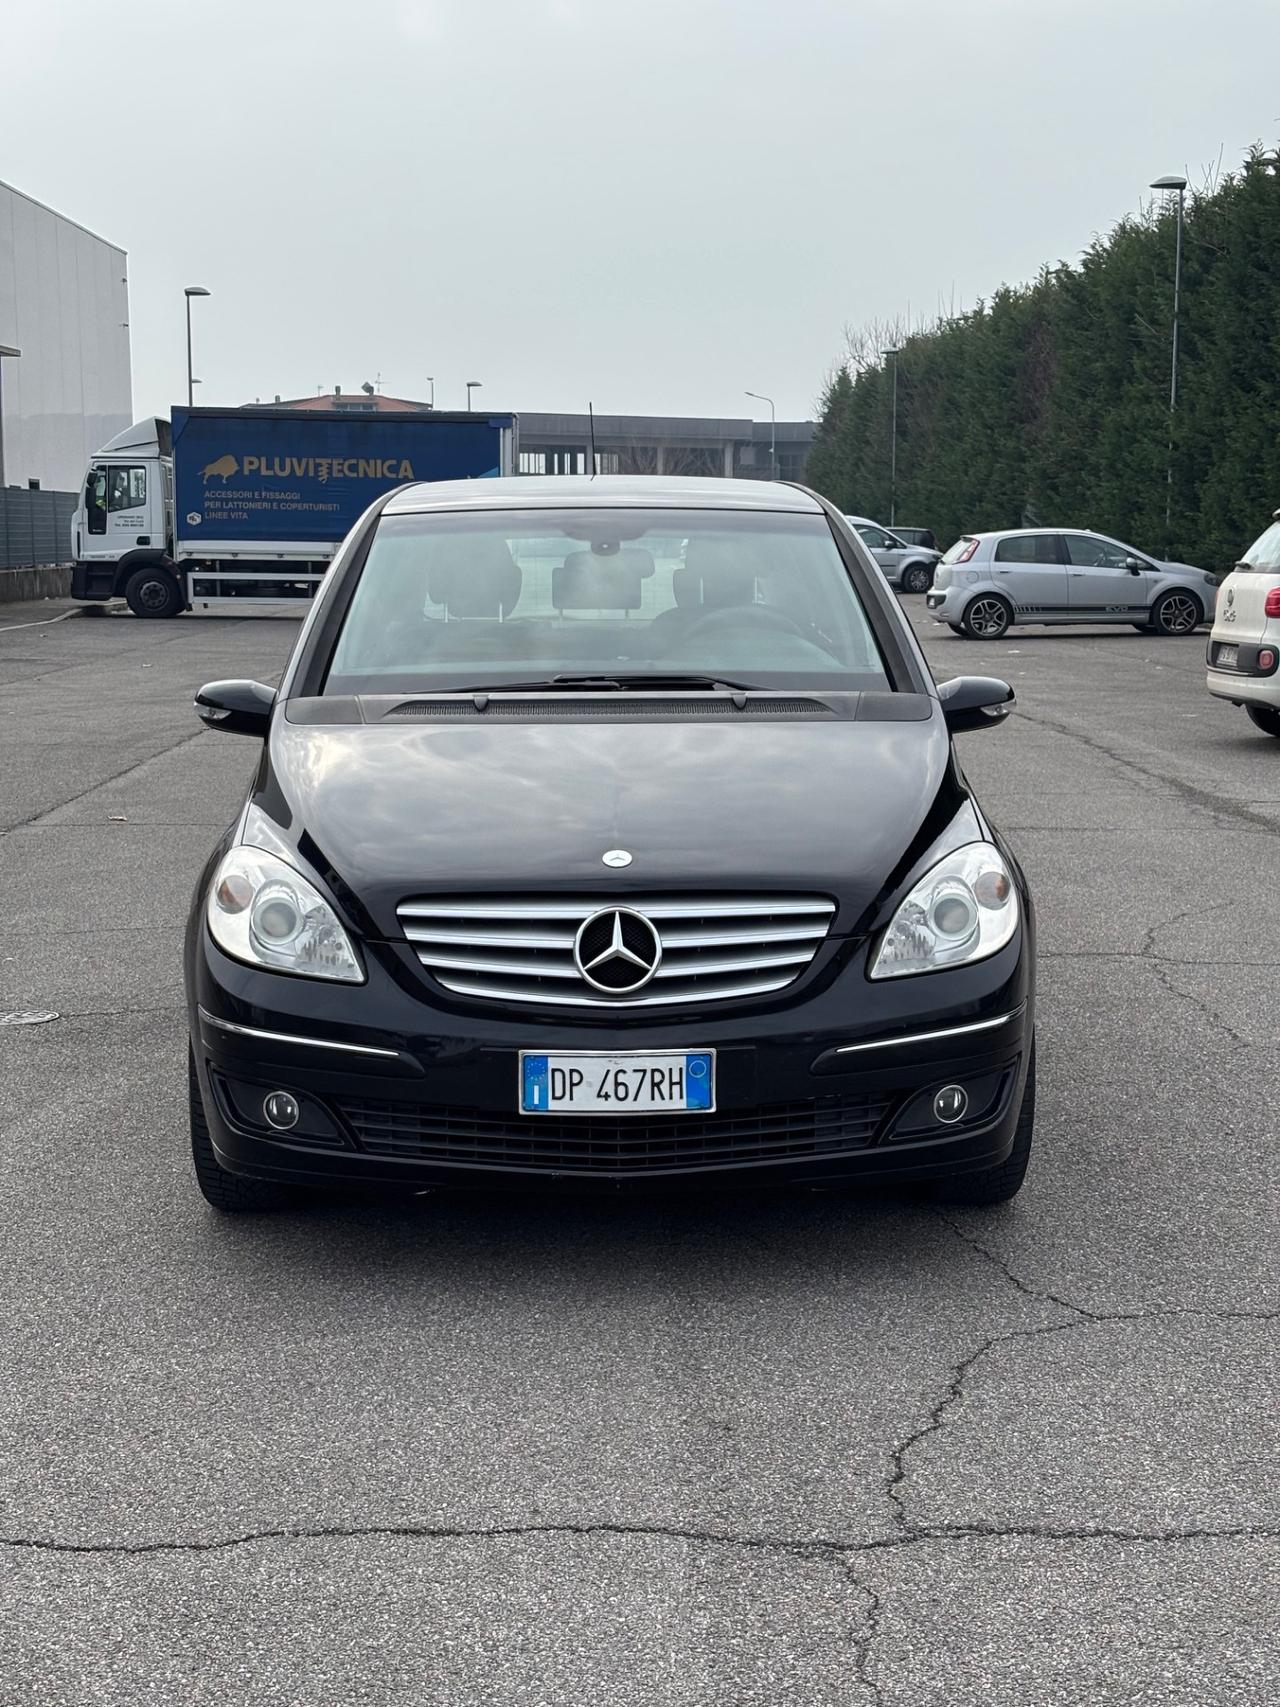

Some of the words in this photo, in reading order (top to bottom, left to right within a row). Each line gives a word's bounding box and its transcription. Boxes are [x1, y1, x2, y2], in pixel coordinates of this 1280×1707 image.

[243, 456, 415, 484] PLUVITECNICA
[204, 491, 253, 499] ACCESSORI
[254, 491, 261, 499] E
[262, 491, 301, 500] FISSAGGI
[204, 501, 222, 509] PER
[223, 501, 272, 510] LATTONIERI
[273, 502, 279, 510] E
[280, 502, 340, 511] COPERTURISTI
[204, 511, 228, 520] LINEE
[230, 511, 249, 520] VITA
[551, 1067, 584, 1101] DP
[596, 1067, 684, 1102] 467RH
